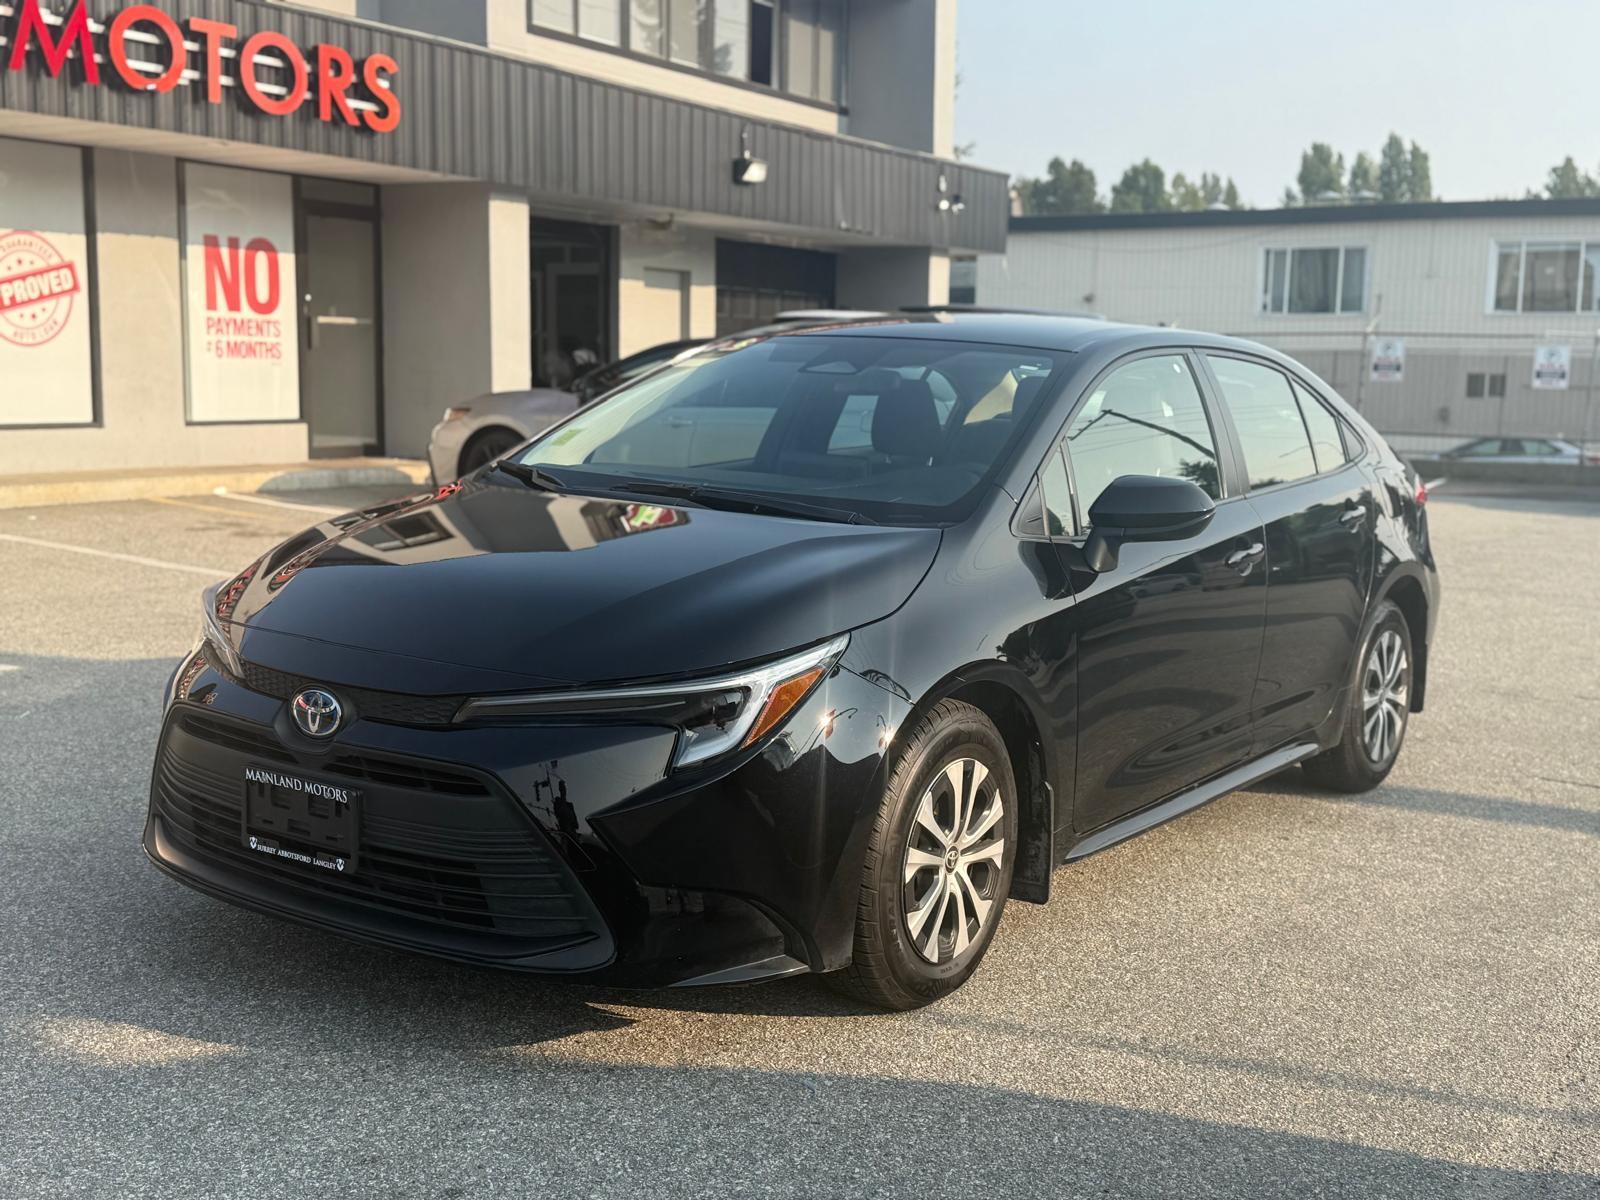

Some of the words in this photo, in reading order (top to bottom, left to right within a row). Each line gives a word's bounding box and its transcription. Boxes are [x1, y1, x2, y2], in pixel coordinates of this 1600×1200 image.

[9, 0, 401, 134] MOTORS
[203, 234, 280, 315] NO
[206, 317, 281, 338] PAYMENTS
[226, 341, 282, 360] MONTHS
[245, 768, 302, 791] MAINLAND
[304, 782, 348, 804] MOTORS
[257, 844, 276, 855] SURREY
[277, 850, 311, 864] ABBOTSFORD
[313, 858, 336, 870] LANGLEY
